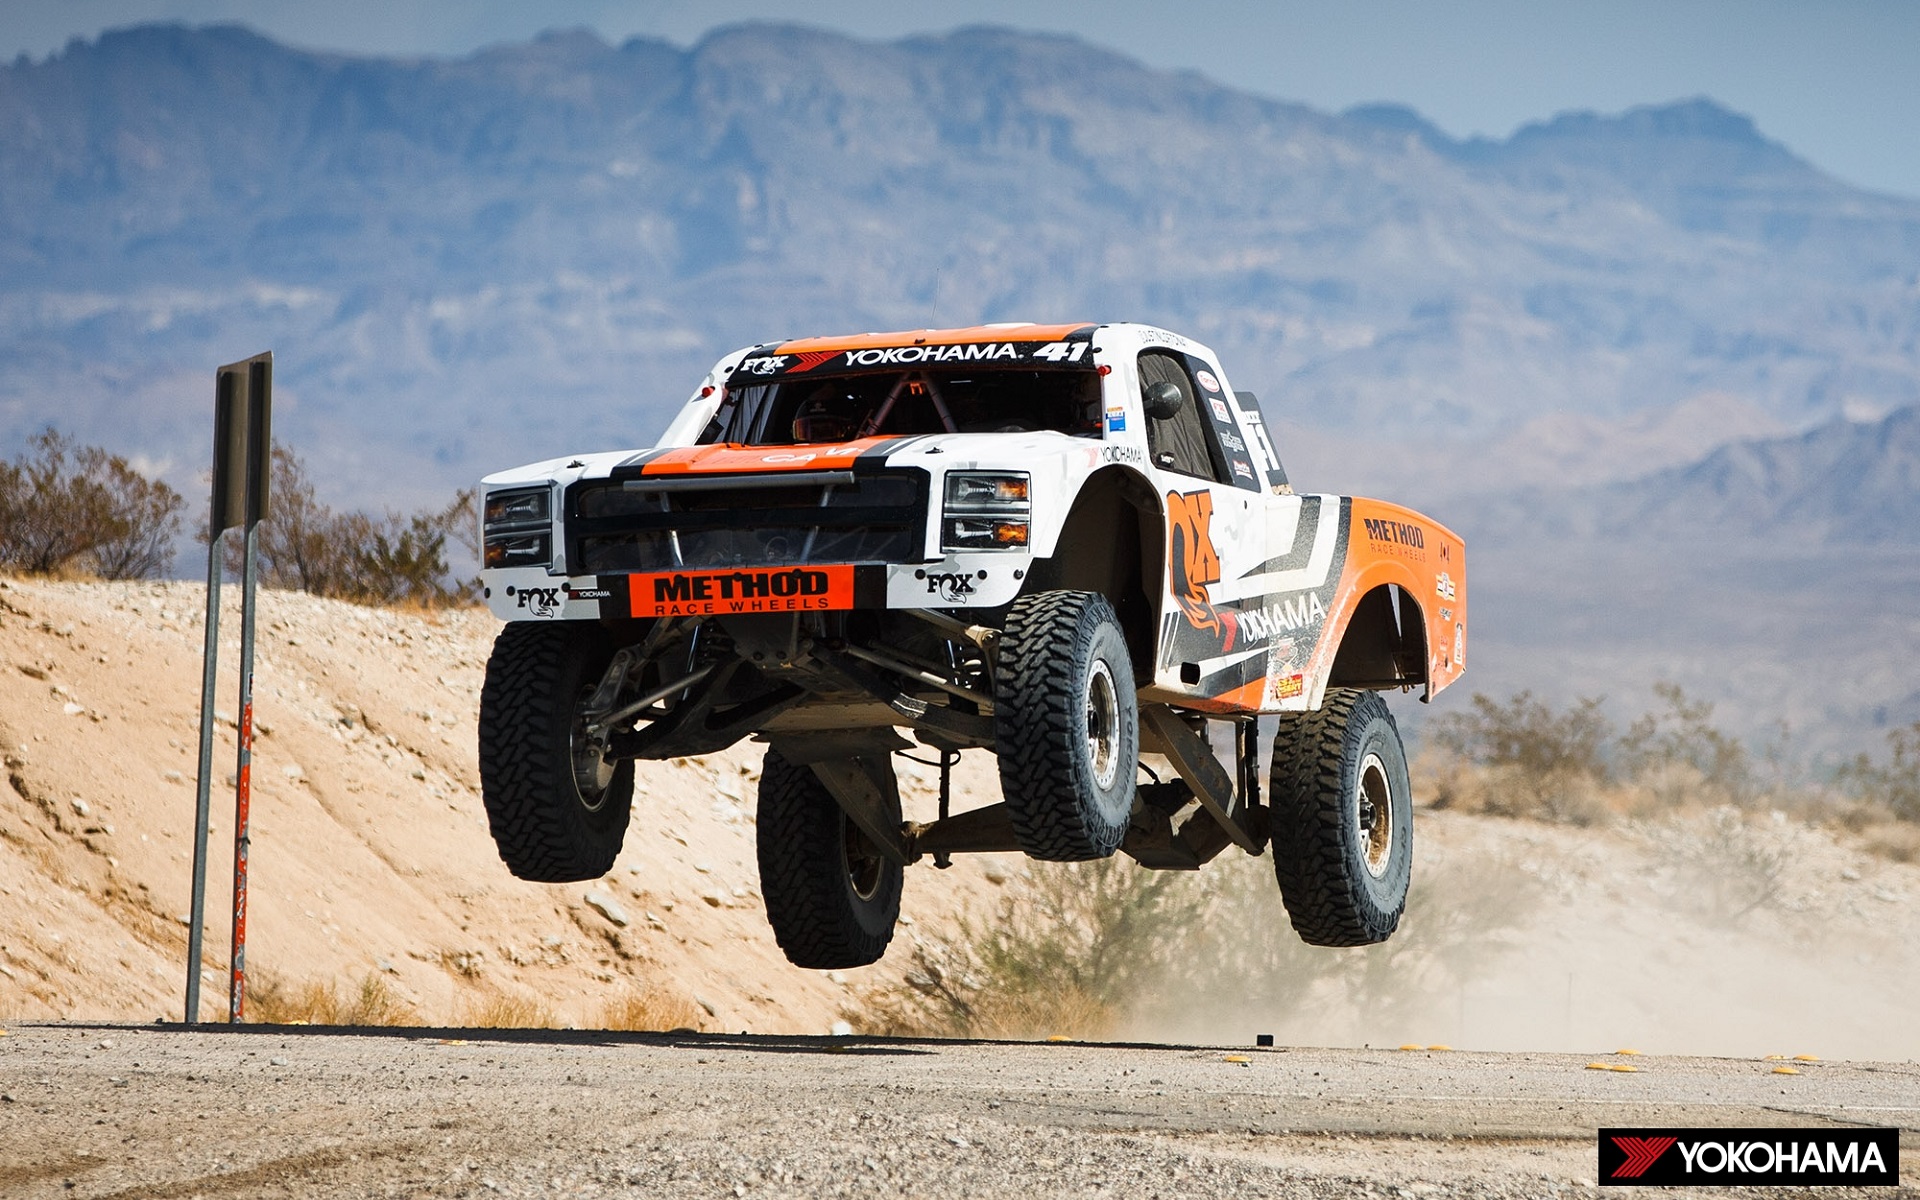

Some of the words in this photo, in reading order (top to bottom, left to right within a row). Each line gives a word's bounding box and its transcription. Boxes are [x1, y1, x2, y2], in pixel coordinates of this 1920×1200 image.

[740, 355, 789, 375] FOX
[844, 343, 1021, 367] YOKOHAMA
[1032, 341, 1091, 363] 41
[1363, 518, 1424, 549] METHOD
[653, 571, 829, 602] METHOD
[927, 573, 974, 604] FOX
[517, 588, 560, 619] FOX
[655, 603, 714, 616] RACE
[730, 598, 829, 613] WHEELS
[1235, 592, 1327, 643] YOKOHAMA
